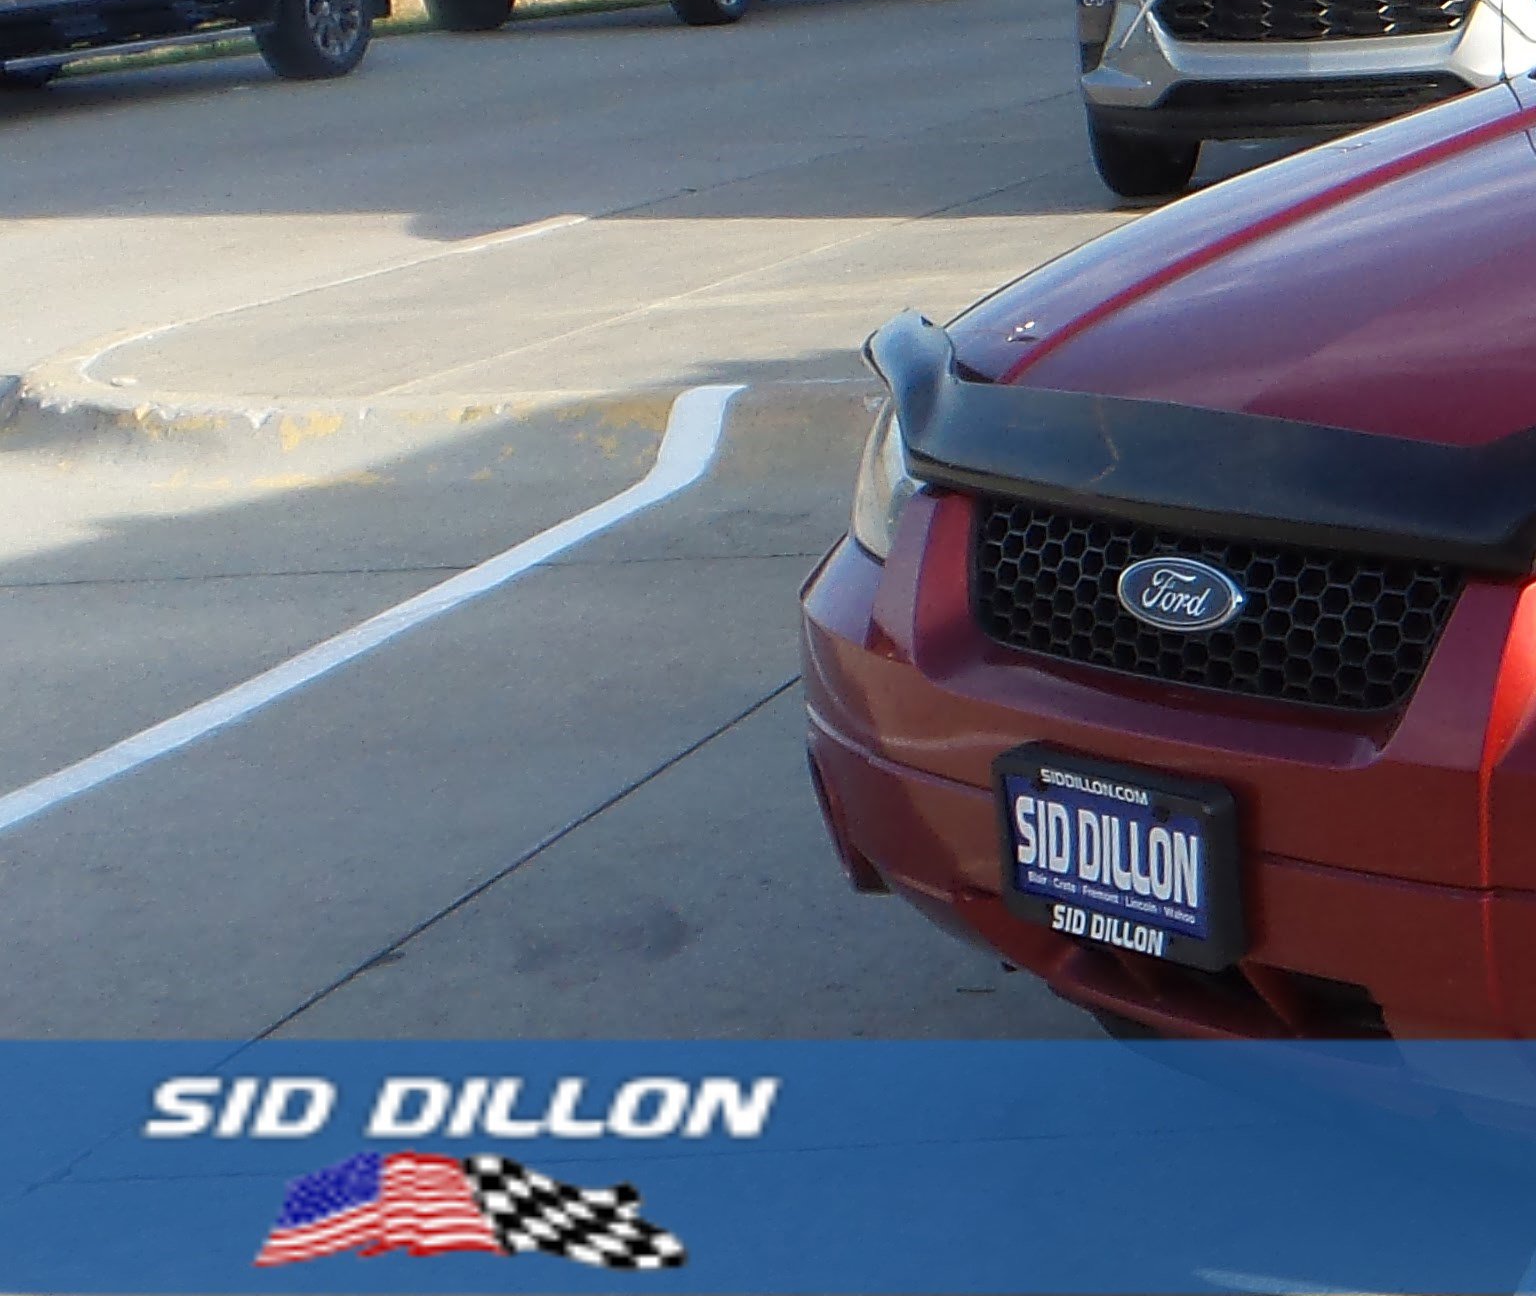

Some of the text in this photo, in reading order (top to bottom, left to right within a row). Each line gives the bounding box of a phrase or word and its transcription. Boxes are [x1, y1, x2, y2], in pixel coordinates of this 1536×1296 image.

[1142, 569, 1211, 616] Ford
[1040, 768, 1149, 806] SIDDILLON.COM
[1016, 795, 1198, 908] SID DILLON
[1052, 904, 1164, 957] SID DILLON
